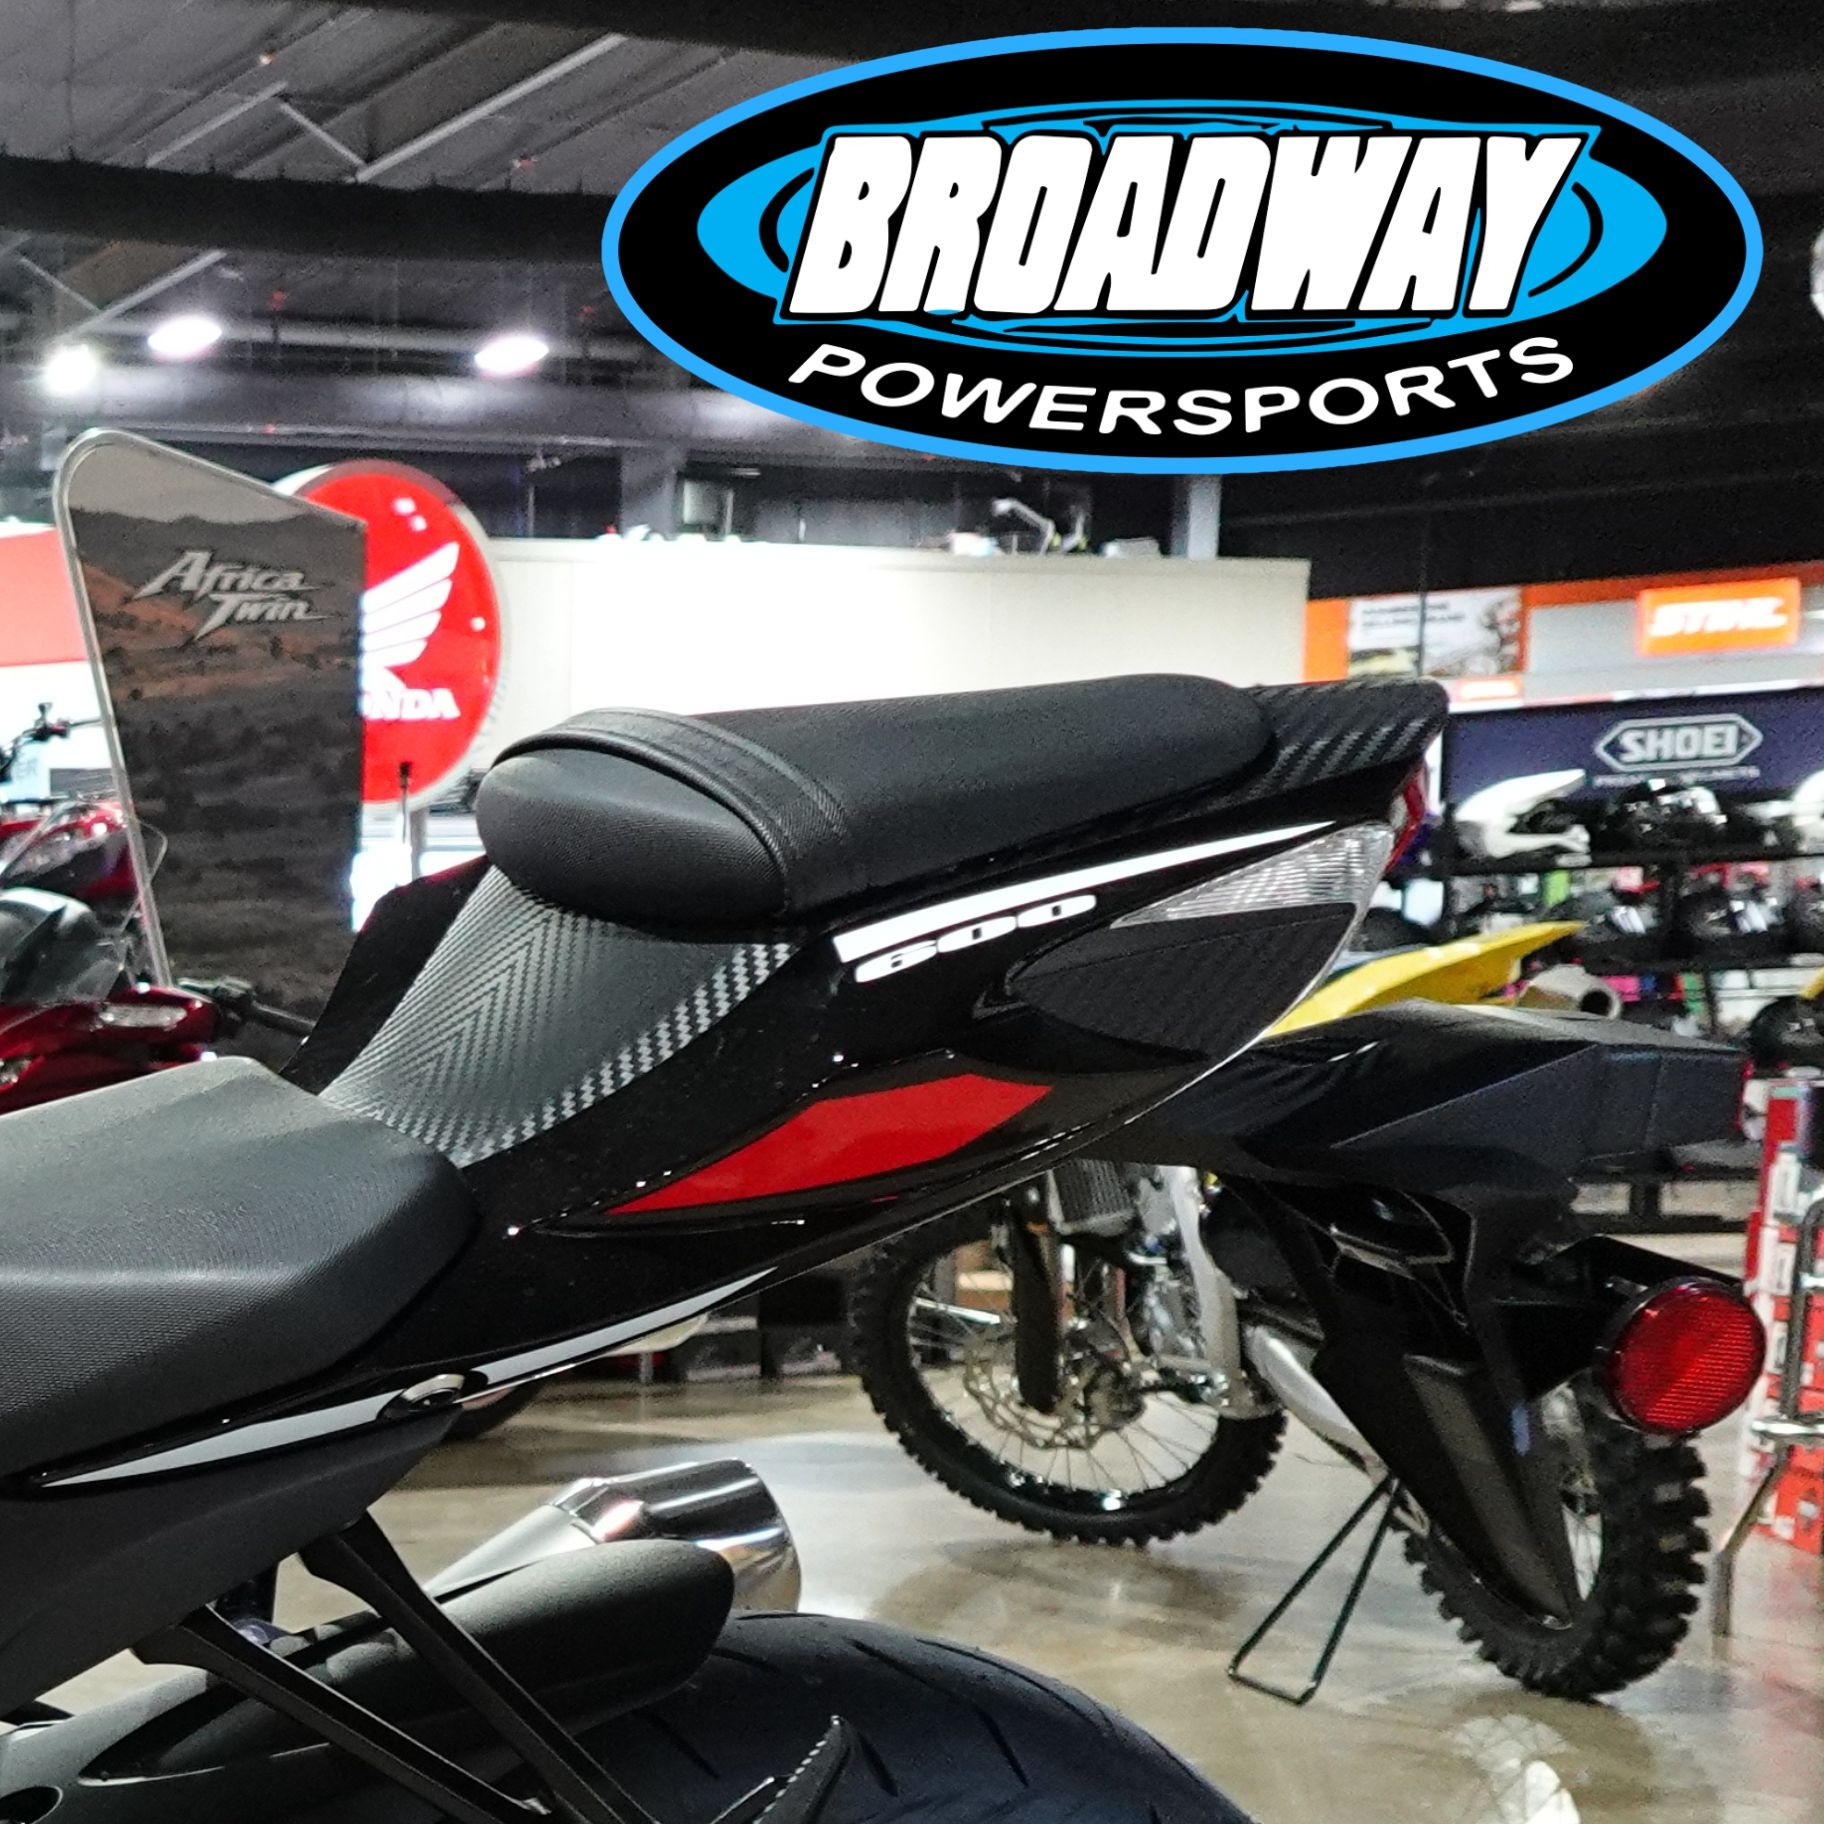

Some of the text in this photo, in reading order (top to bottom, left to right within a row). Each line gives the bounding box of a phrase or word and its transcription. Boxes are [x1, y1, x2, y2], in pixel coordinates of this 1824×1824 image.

[134, 550, 322, 601] Africa
[195, 592, 329, 641] Twin
[1618, 722, 1739, 764] SHOEI
